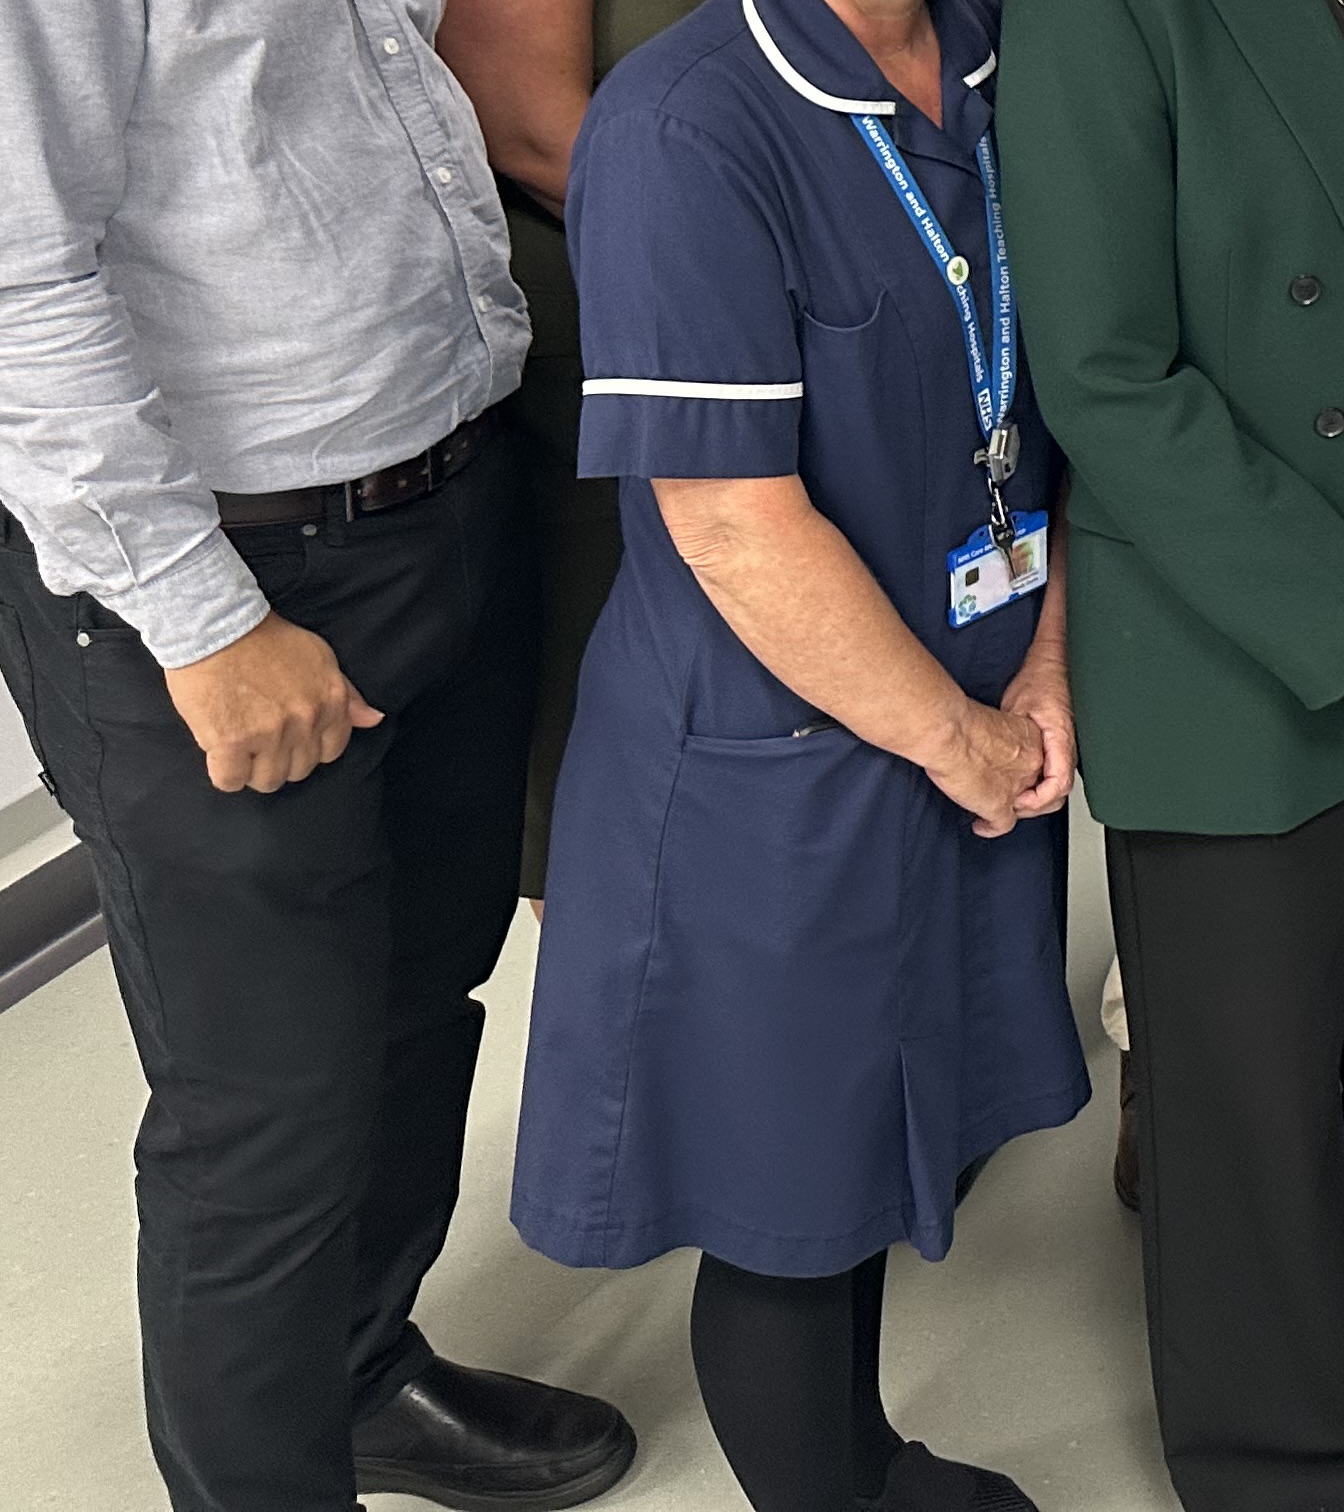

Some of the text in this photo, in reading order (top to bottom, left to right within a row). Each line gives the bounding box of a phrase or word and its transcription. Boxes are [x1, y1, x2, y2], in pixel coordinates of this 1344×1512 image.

[992, 202, 1008, 264] Teaching
[862, 116, 993, 431] Warrington and Halton ching Hospitals NHS
[998, 265, 1012, 313] Halton
[999, 316, 1011, 344] and
